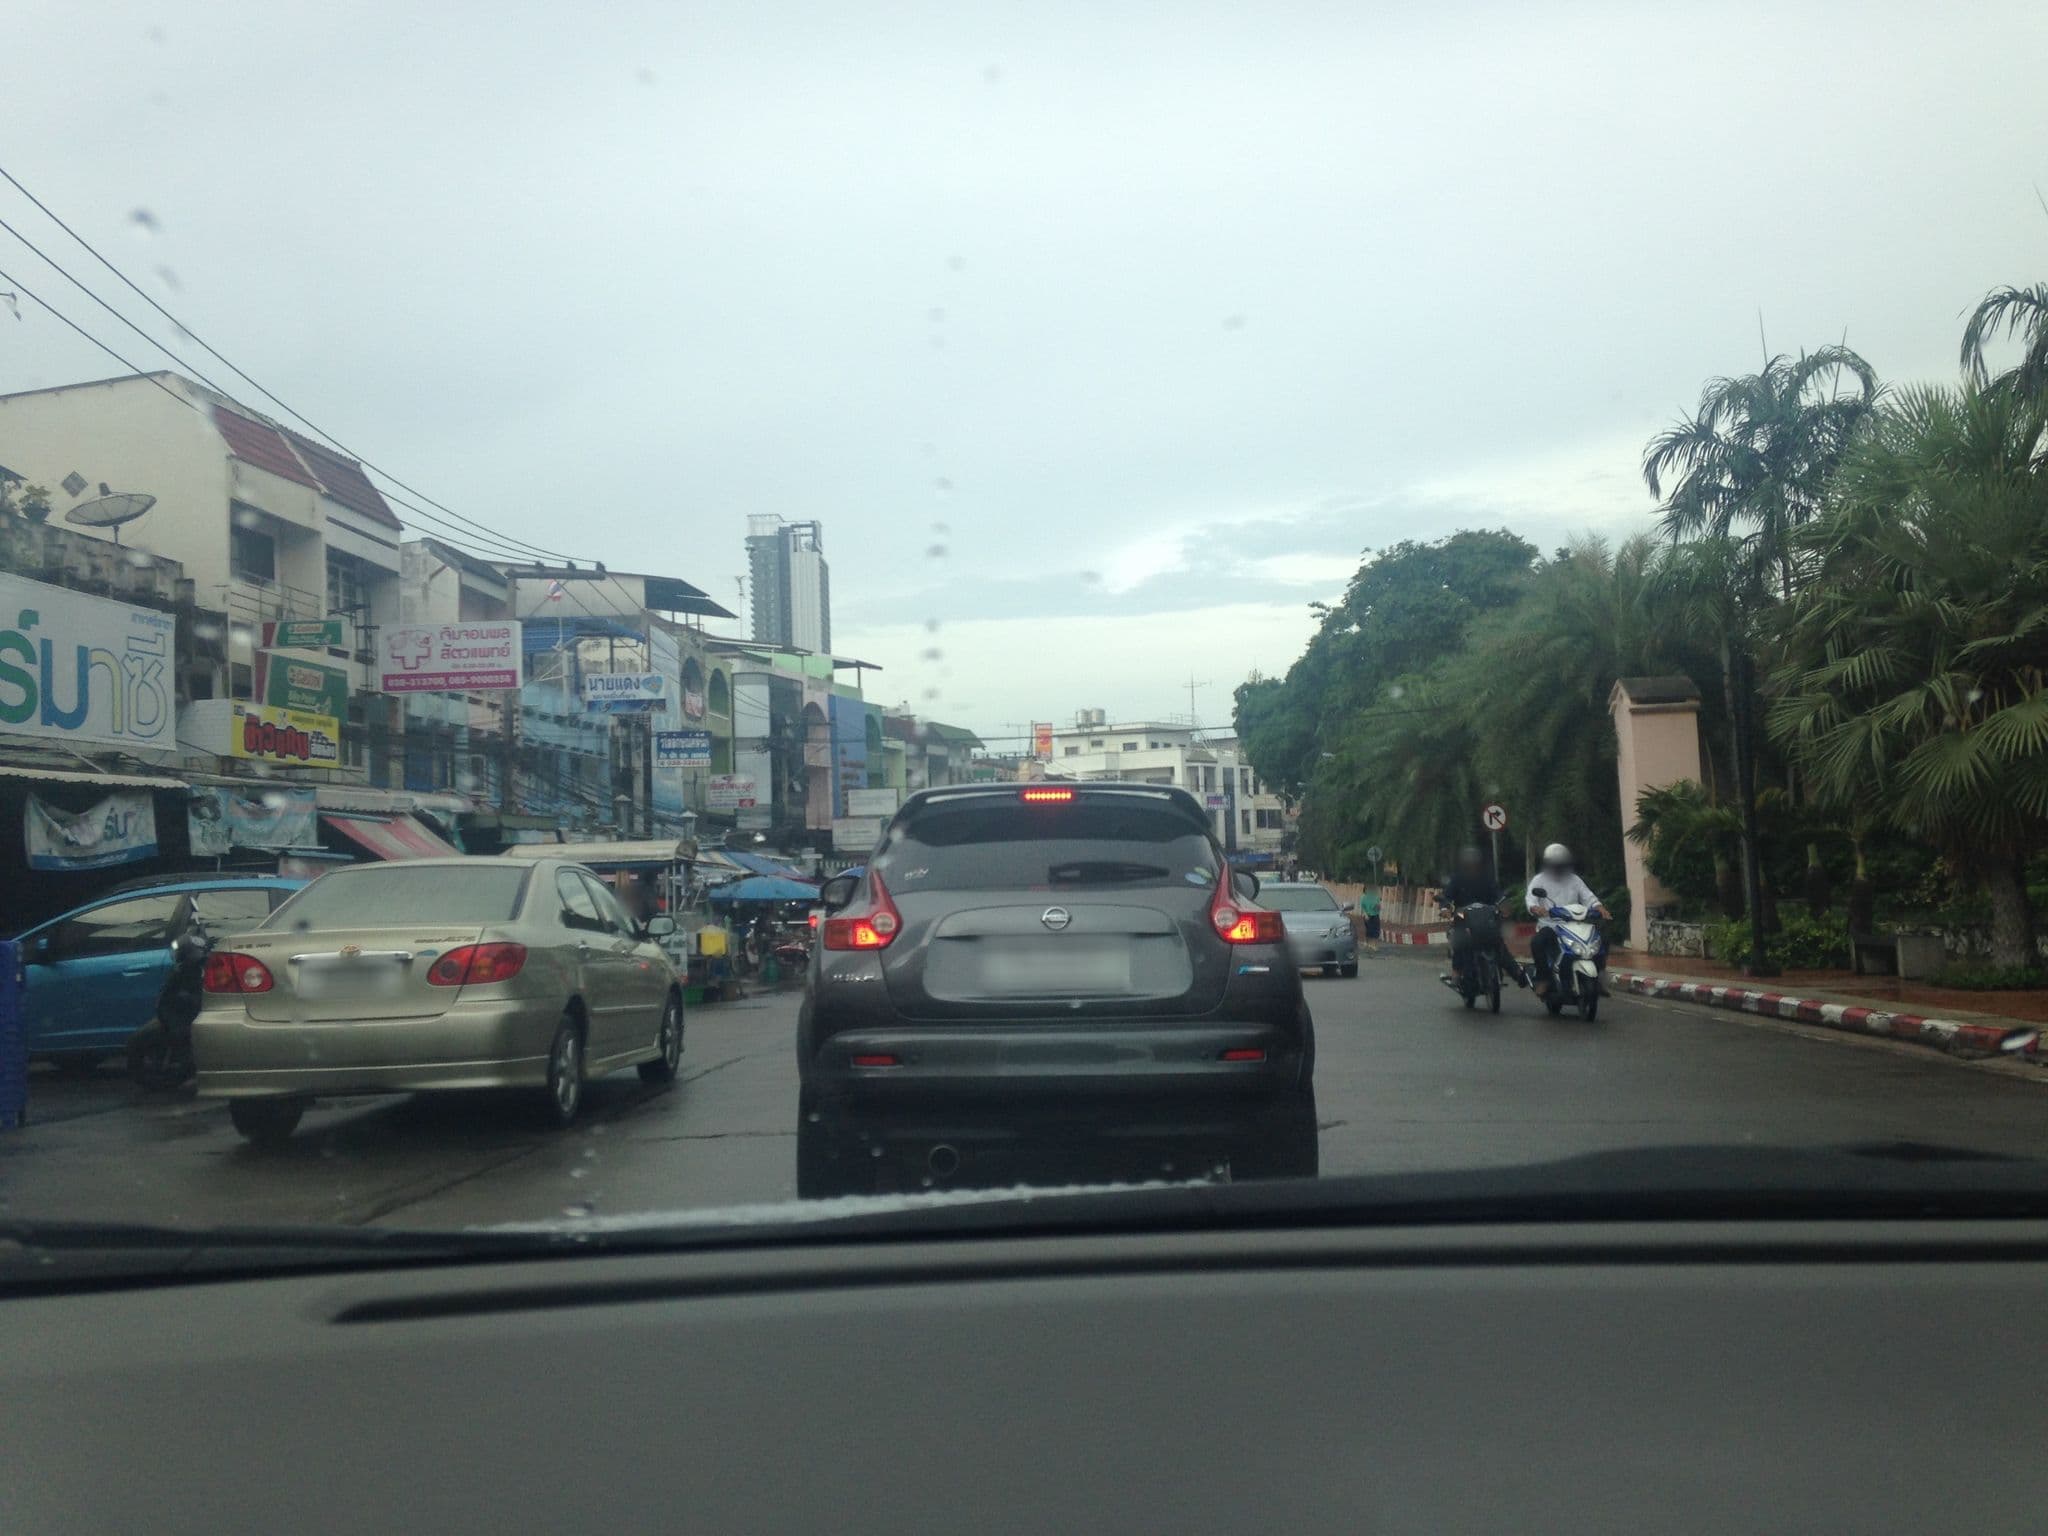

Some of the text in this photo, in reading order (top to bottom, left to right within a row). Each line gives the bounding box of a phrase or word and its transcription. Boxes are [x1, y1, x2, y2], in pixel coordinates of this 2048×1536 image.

[440, 641, 511, 659] สัตวแพทย์
[588, 677, 641, 692] นายแดง
